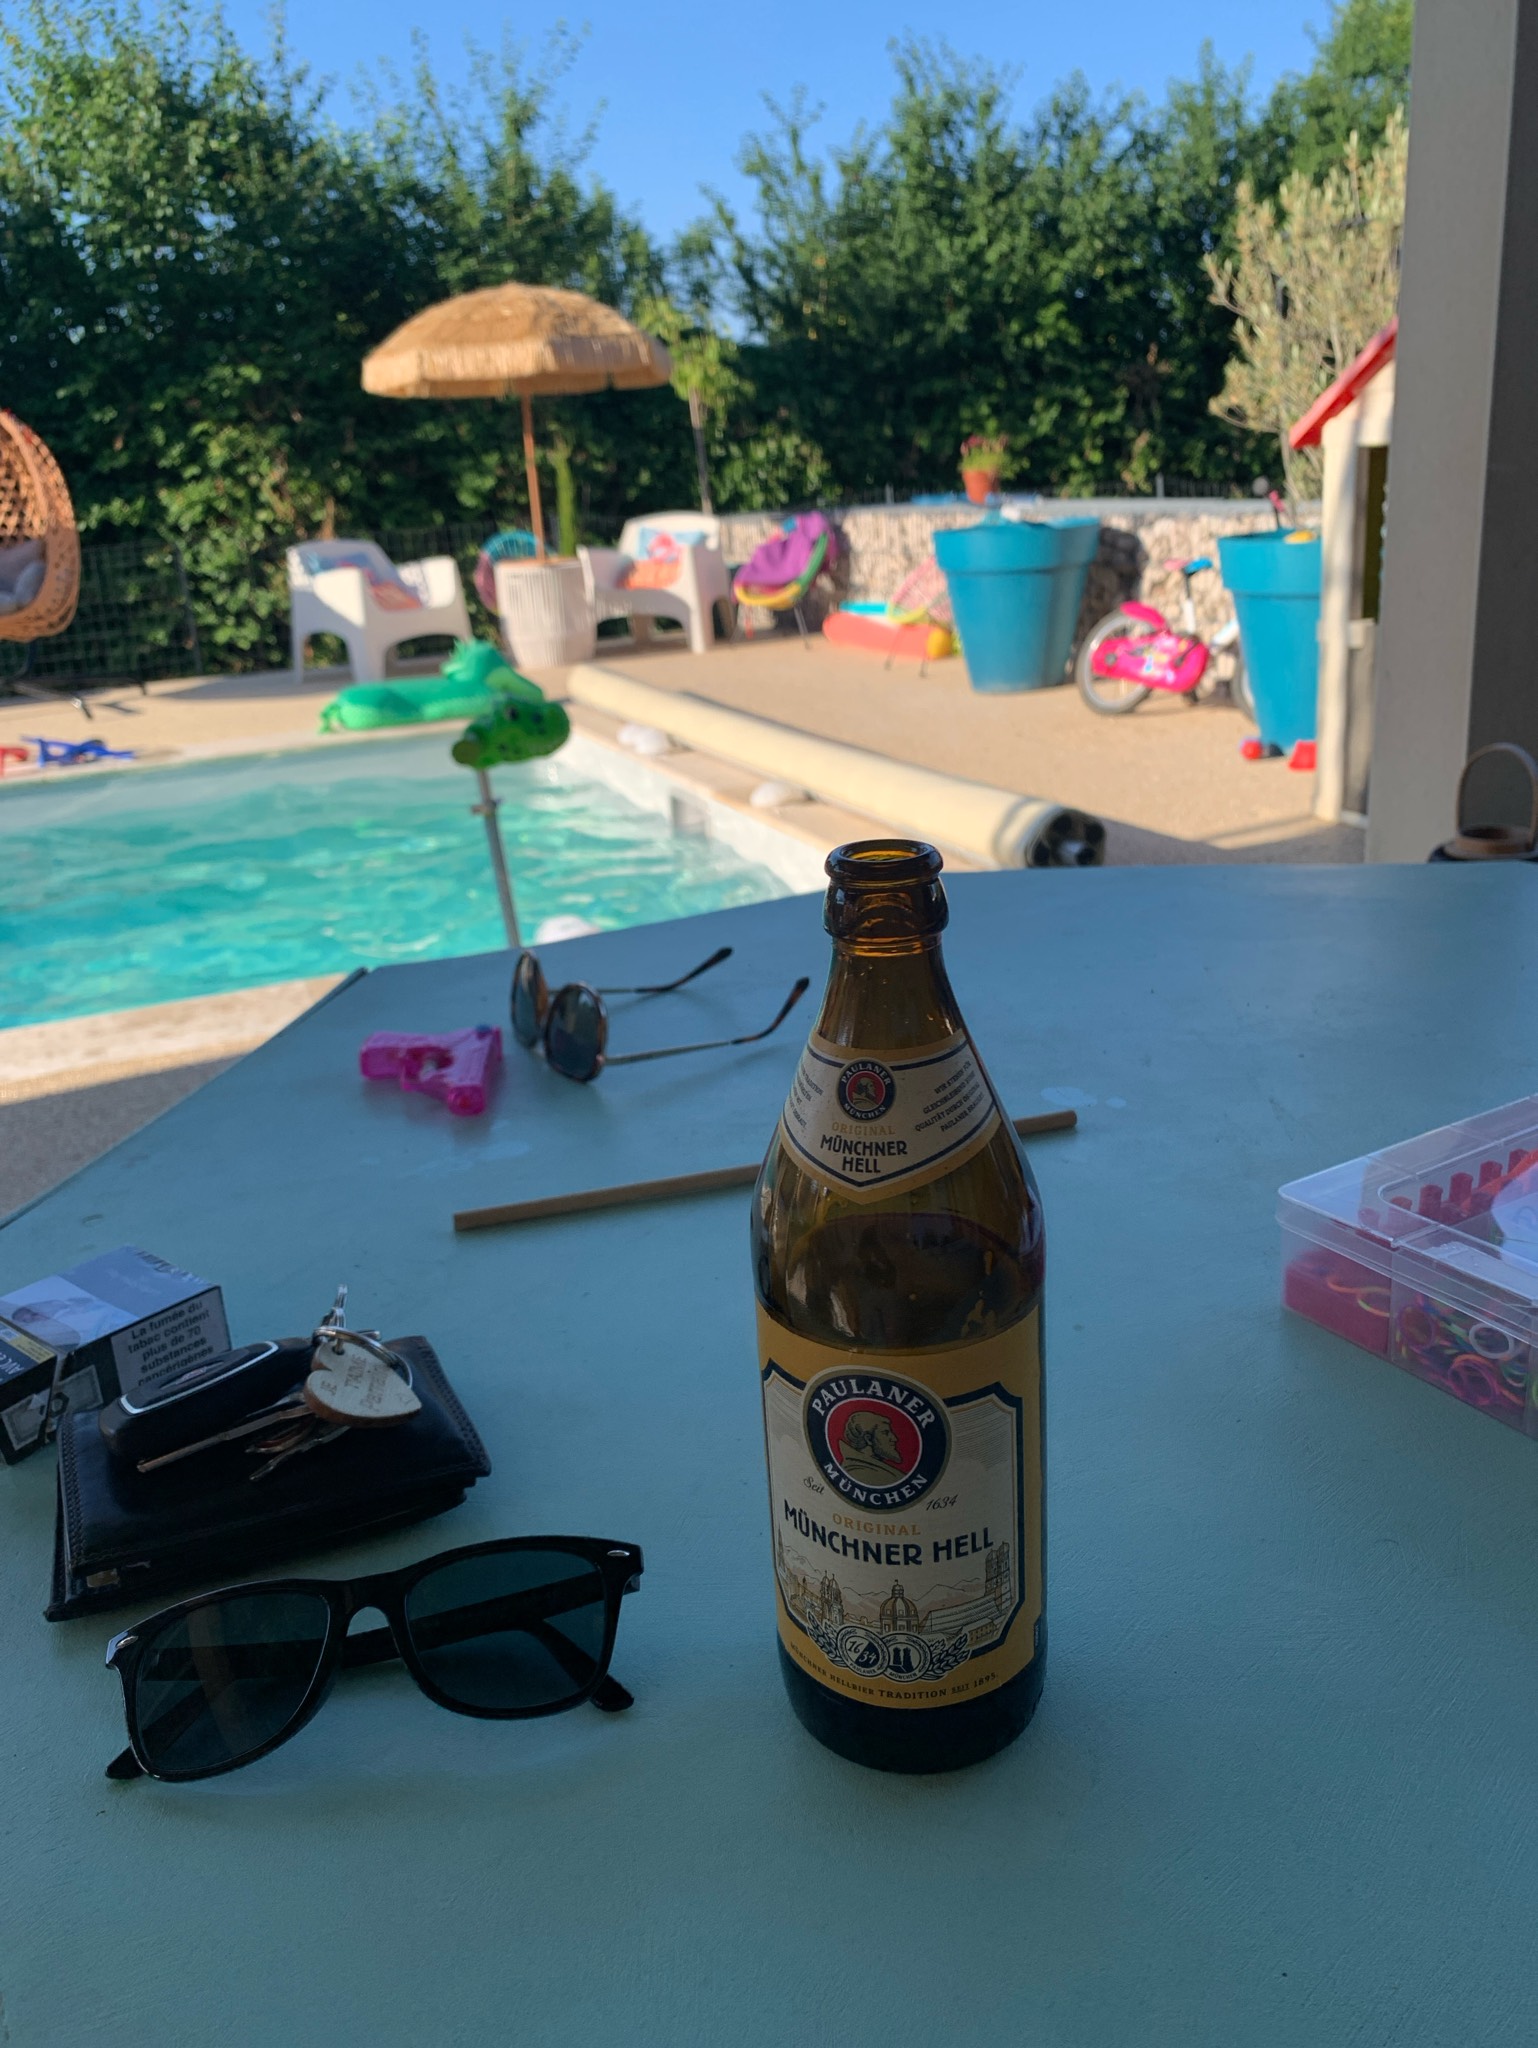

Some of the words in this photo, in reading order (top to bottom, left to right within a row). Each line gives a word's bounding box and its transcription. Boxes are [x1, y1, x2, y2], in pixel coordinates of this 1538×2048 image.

[842, 1061, 891, 1087] PAULANER
[843, 1102, 887, 1120] MÜNCHEN
[915, 1111, 946, 1132] QUALITÄT
[831, 1121, 896, 1135] ORIGINAL
[820, 1134, 908, 1156] MÜNCHNER
[842, 1156, 881, 1174] HELL
[128, 1332, 163, 1355] tabac
[163, 1309, 211, 1339] contient
[130, 1324, 147, 1341] La
[150, 1308, 185, 1334] fumée
[188, 1300, 203, 1314] du
[140, 1337, 208, 1374] substances
[142, 1341, 169, 1363] plus
[170, 1333, 185, 1348] de
[187, 1325, 202, 1342] 70
[811, 1378, 937, 1430] PAULANER
[803, 1476, 825, 1496] Seit
[823, 1461, 930, 1505] MÜNCHEN
[925, 1494, 959, 1512] 1634
[783, 1498, 923, 1566] MÜNCHNER
[932, 1526, 994, 1563] HELL
[832, 1512, 922, 1537] ORIGINAL
[846, 1639, 860, 1655] 16
[858, 1650, 879, 1665] 34
[790, 1641, 828, 1677] MÜNCHNER
[829, 1673, 875, 1696] HELLBIER
[877, 1688, 948, 1700] TRADITION
[951, 1683, 970, 1695] SEIT
